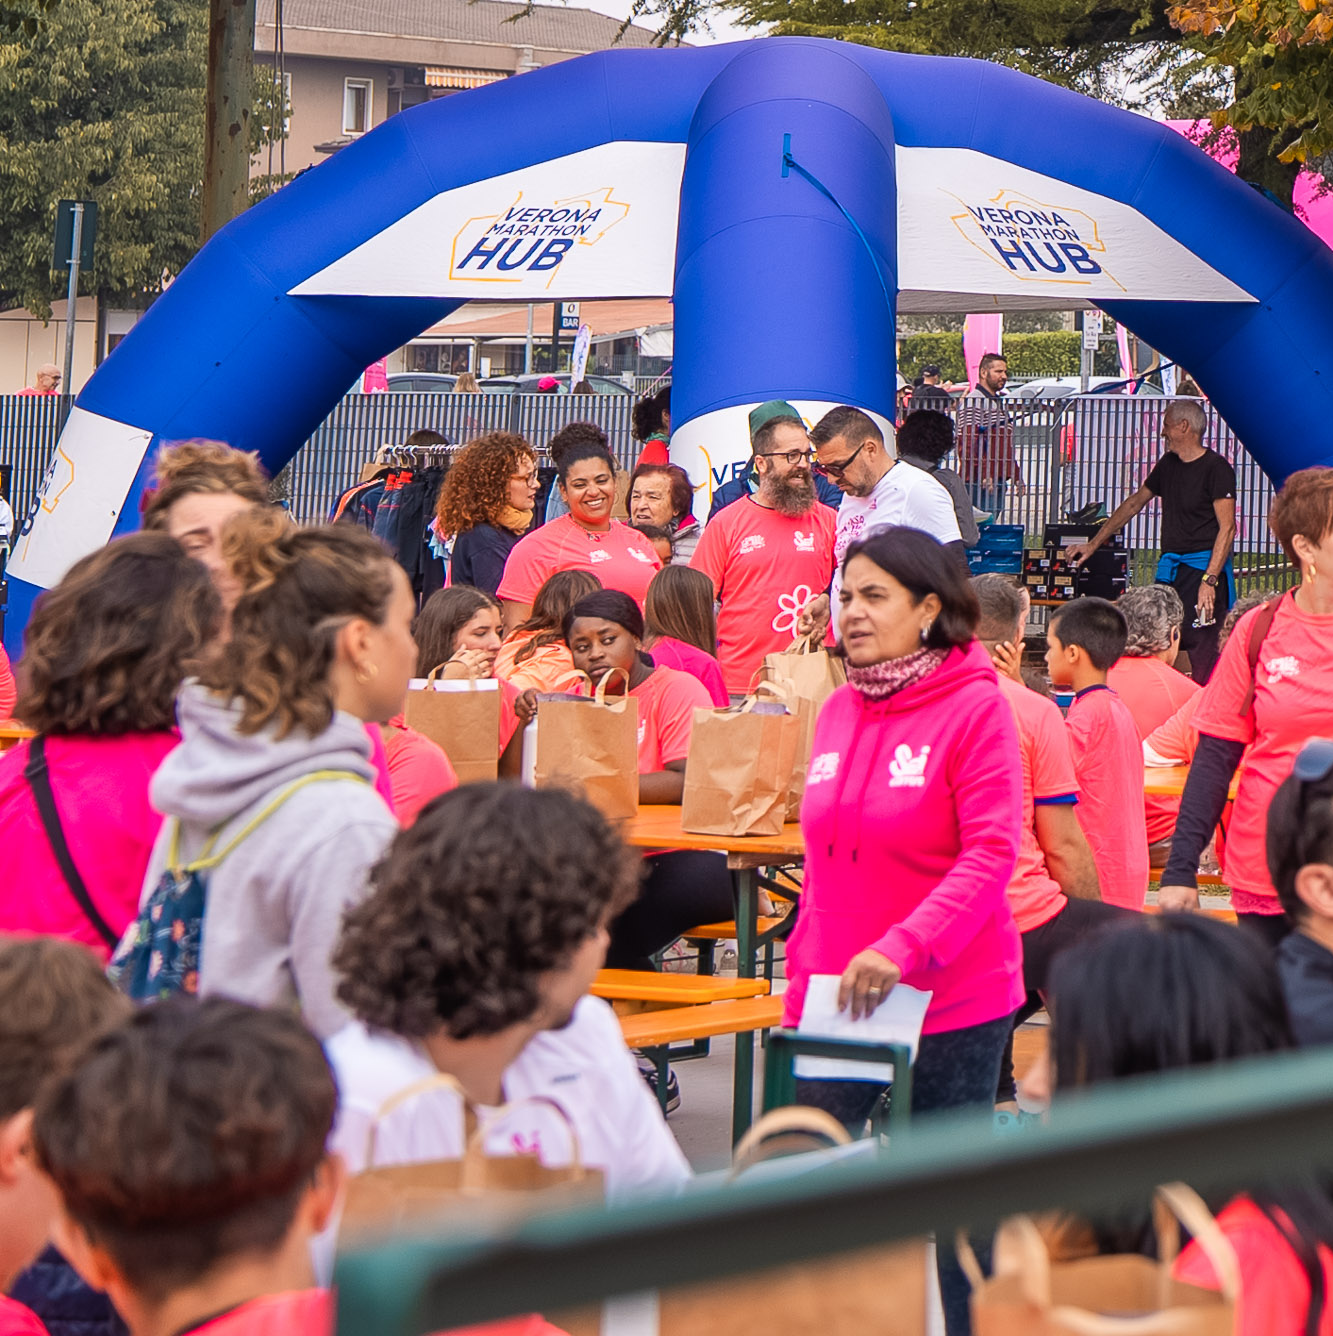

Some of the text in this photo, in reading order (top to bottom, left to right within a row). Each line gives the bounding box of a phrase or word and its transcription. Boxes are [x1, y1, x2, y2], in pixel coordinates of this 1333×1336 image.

[504, 207, 602, 223] VERONA
[966, 205, 1071, 228] VERONA
[486, 224, 592, 237] MARATHON
[979, 224, 1080, 242] MARATHON
[456, 237, 575, 272] HUB
[989, 238, 1102, 275] HUB
[562, 317, 579, 328] BAR
